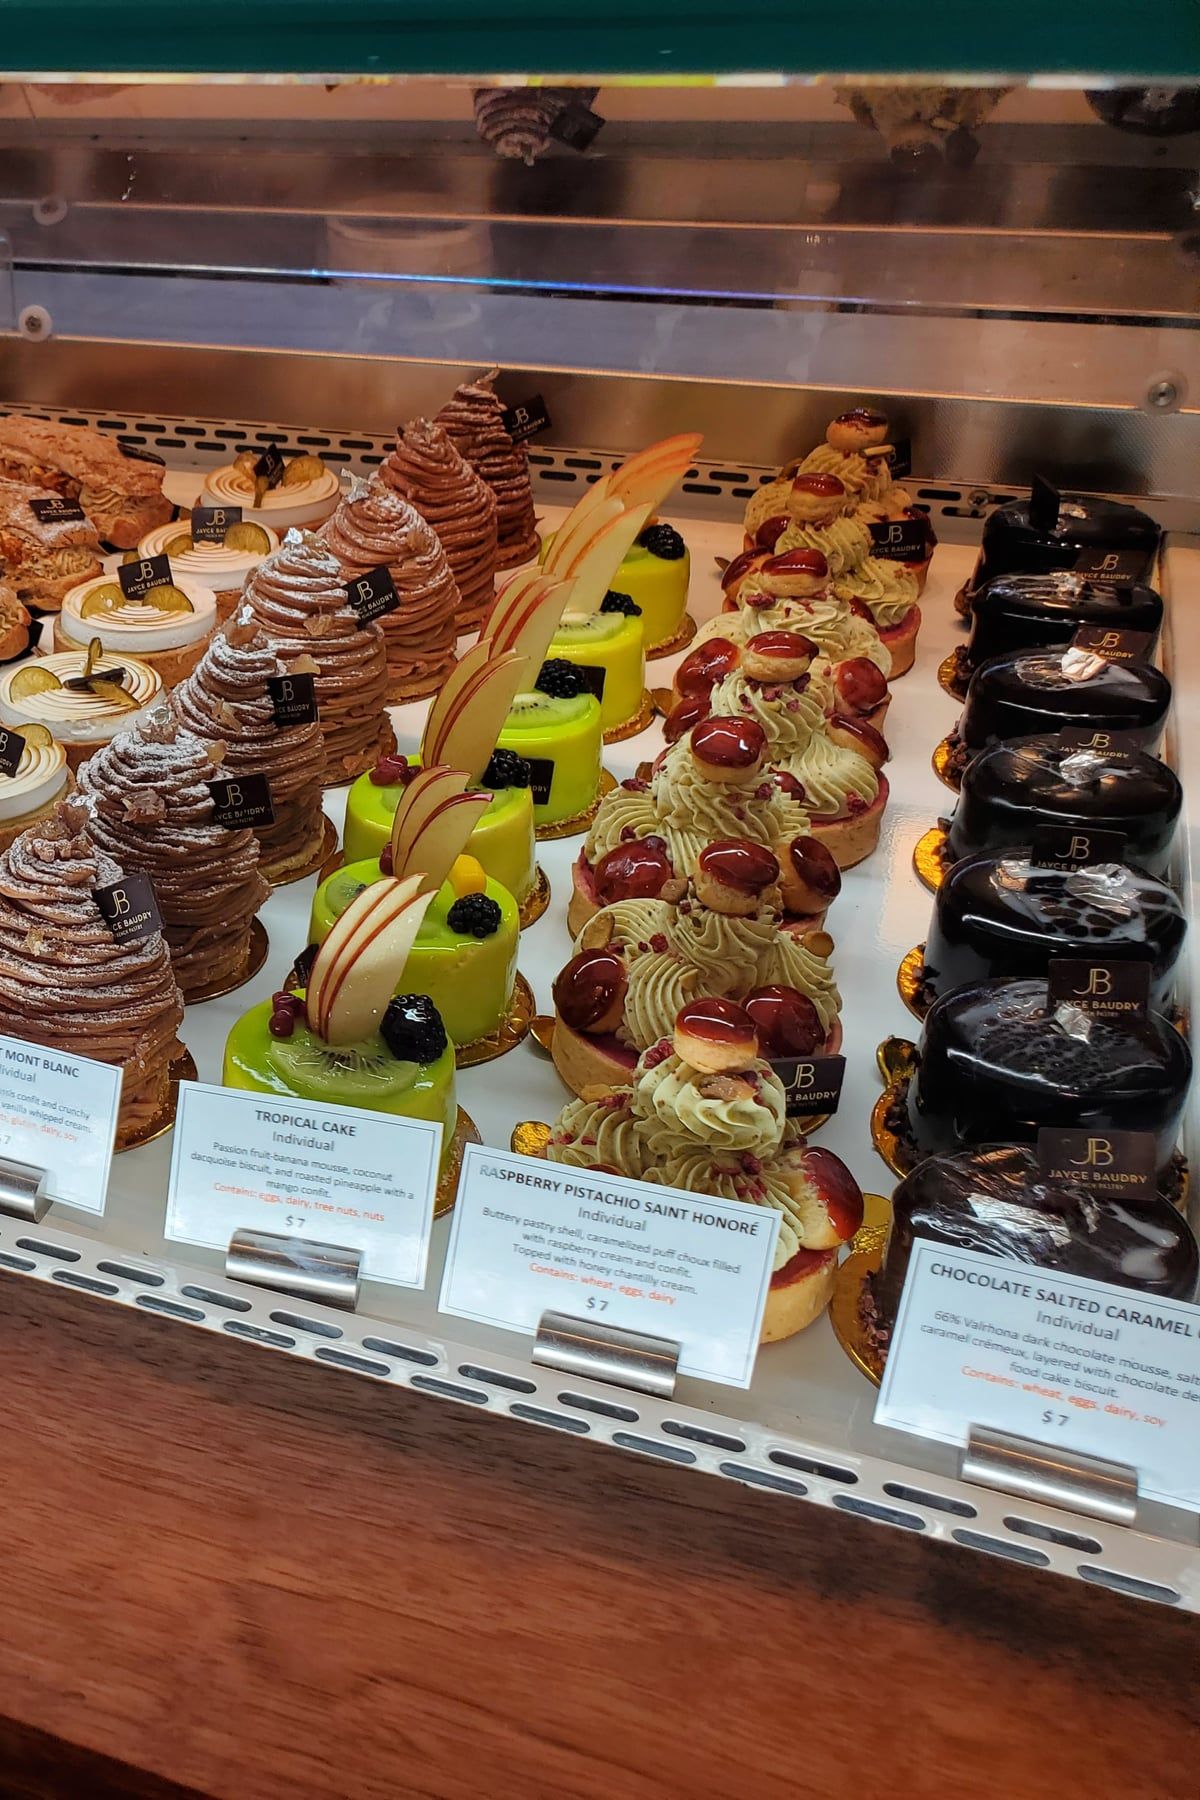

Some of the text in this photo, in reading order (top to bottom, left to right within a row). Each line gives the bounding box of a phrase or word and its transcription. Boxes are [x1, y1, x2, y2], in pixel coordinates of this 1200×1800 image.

[123, 911, 152, 927] BAUDRY
[1092, 1001, 1140, 1010] BAUDRY
[5, 1049, 40, 1066] MONT
[43, 1059, 78, 1077] BLANC
[795, 1091, 837, 1101] BAUDRY
[255, 1110, 356, 1136] TROPICAL CAKE
[272, 1131, 334, 1150] Individual
[190, 1151, 237, 1167] dacquoise
[274, 1168, 293, 1177] and
[294, 1172, 331, 1184] roasted
[333, 1178, 381, 1193] pineapple
[384, 1188, 406, 1197] with
[212, 1141, 247, 1155] Passion
[250, 1147, 308, 1166] fruit-banana
[352, 1168, 392, 1181] coconut
[266, 1180, 299, 1192] mango
[1048, 1170, 1148, 1184] JAYCE BAUDRY
[480, 1168, 758, 1235] RASPBERRY PISTACHIO SAINT HONORÉ
[578, 1207, 646, 1230] Individual
[482, 1207, 521, 1224] Buttery
[523, 1218, 555, 1233] pastry
[586, 1233, 650, 1253] caramelized
[652, 1248, 676, 1258] puff
[676, 1250, 710, 1266] choux
[712, 1259, 741, 1273] filled
[522, 1233, 544, 1243] with
[547, 1239, 598, 1258] raspberry
[599, 1251, 633, 1264] cream
[634, 1259, 656, 1269] and
[512, 1243, 551, 1260] Topped
[553, 1255, 576, 1265] with
[579, 1259, 612, 1276] honey
[930, 1263, 1192, 1336] CHOCOLATE SALTED CARAMEL
[934, 1310, 961, 1324] 66%
[1022, 1333, 1050, 1347] dark
[1052, 1341, 1115, 1364] chocolate
[1036, 1310, 1119, 1340] Individual
[920, 1324, 970, 1342] caramel
[1032, 1351, 1080, 1371] layered
[1082, 1366, 1112, 1379] with
[1114, 1373, 1179, 1396] chocolate
[1009, 1361, 1040, 1377] food
[1041, 1372, 1071, 1385] cake
